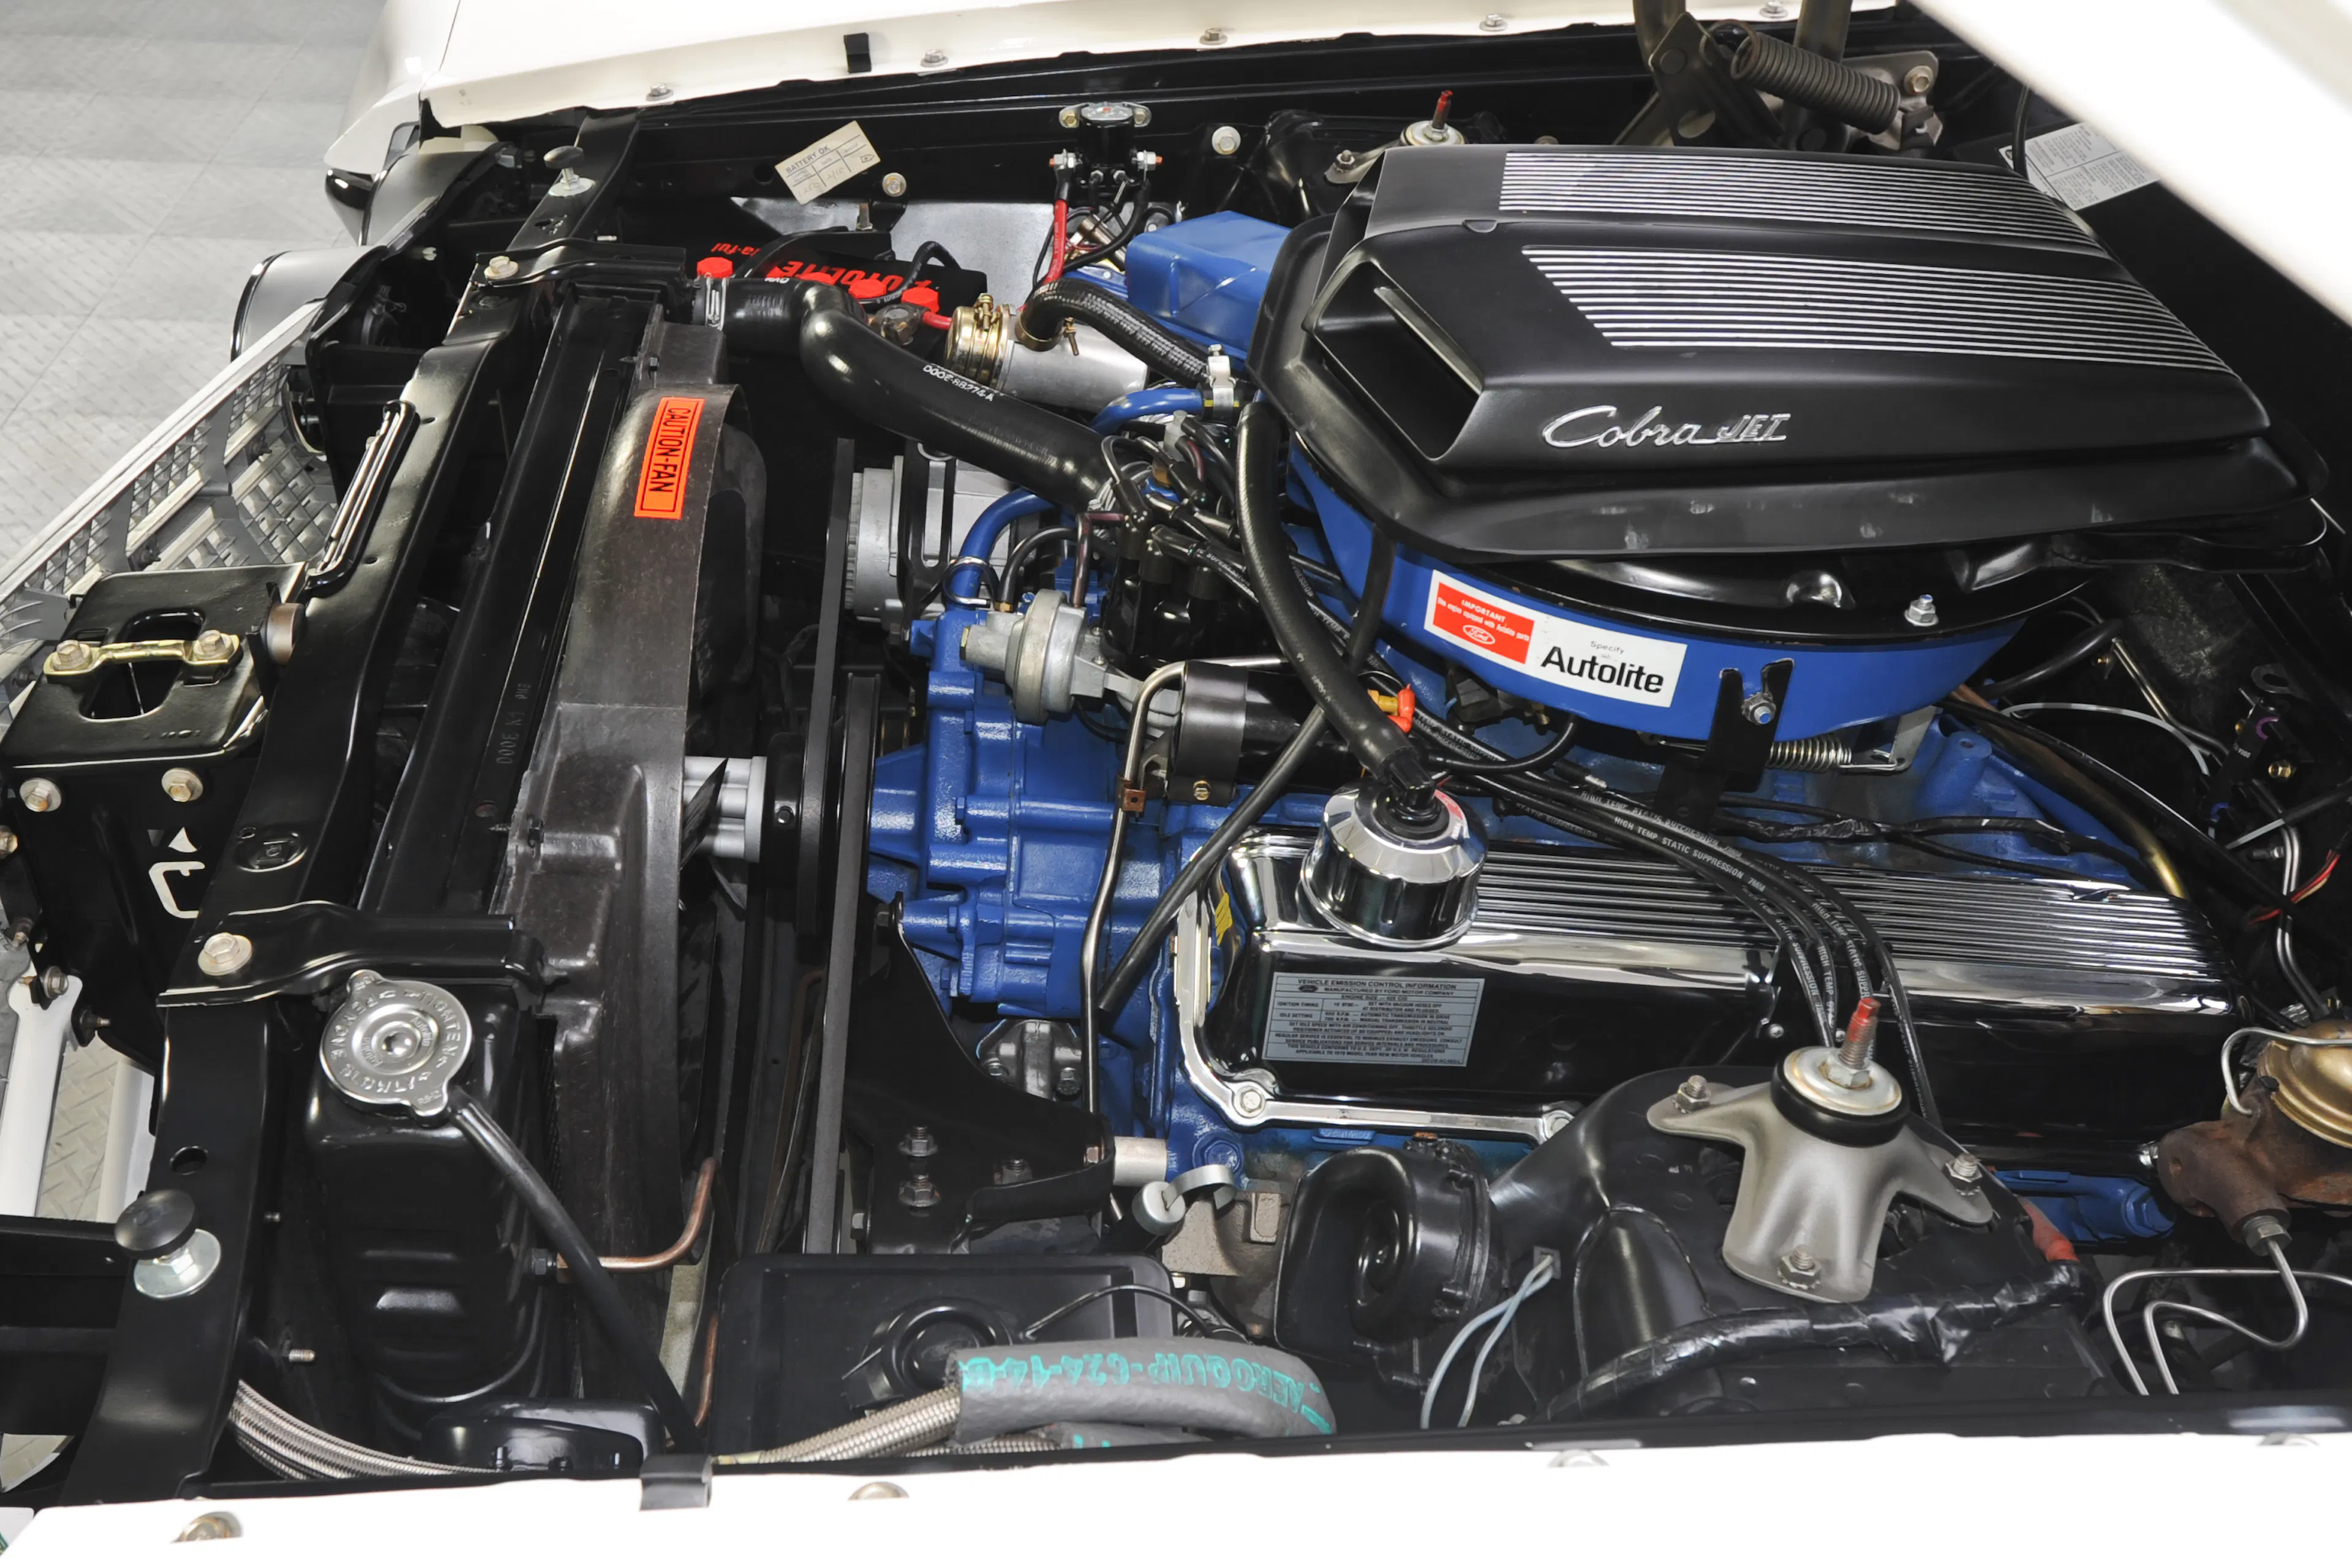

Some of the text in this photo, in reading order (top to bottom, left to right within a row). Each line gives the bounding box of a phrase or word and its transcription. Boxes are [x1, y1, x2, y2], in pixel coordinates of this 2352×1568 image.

[786, 152, 816, 173] BATTERY
[818, 145, 831, 154] OK
[1542, 405, 1791, 448] Cobra JET
[648, 407, 692, 492] CAUTION-FAN
[1461, 599, 1506, 622] IMPORTANT
[1466, 626, 1492, 643] Ford
[1590, 641, 1625, 655] Specify
[1540, 646, 1664, 694] Autolite
[1614, 816, 1634, 831] HIGH
[1638, 827, 1658, 841] TEMP
[1662, 837, 1691, 854] STATIC
[1692, 850, 1744, 879] SUPPRESSION
[1812, 902, 1831, 919] HIGH
[1846, 940, 1863, 968] STATIC
[1792, 942, 1820, 997] SUPPRESSION
[1817, 946, 1830, 967] HIGH
[1823, 970, 1834, 995] TEMP
